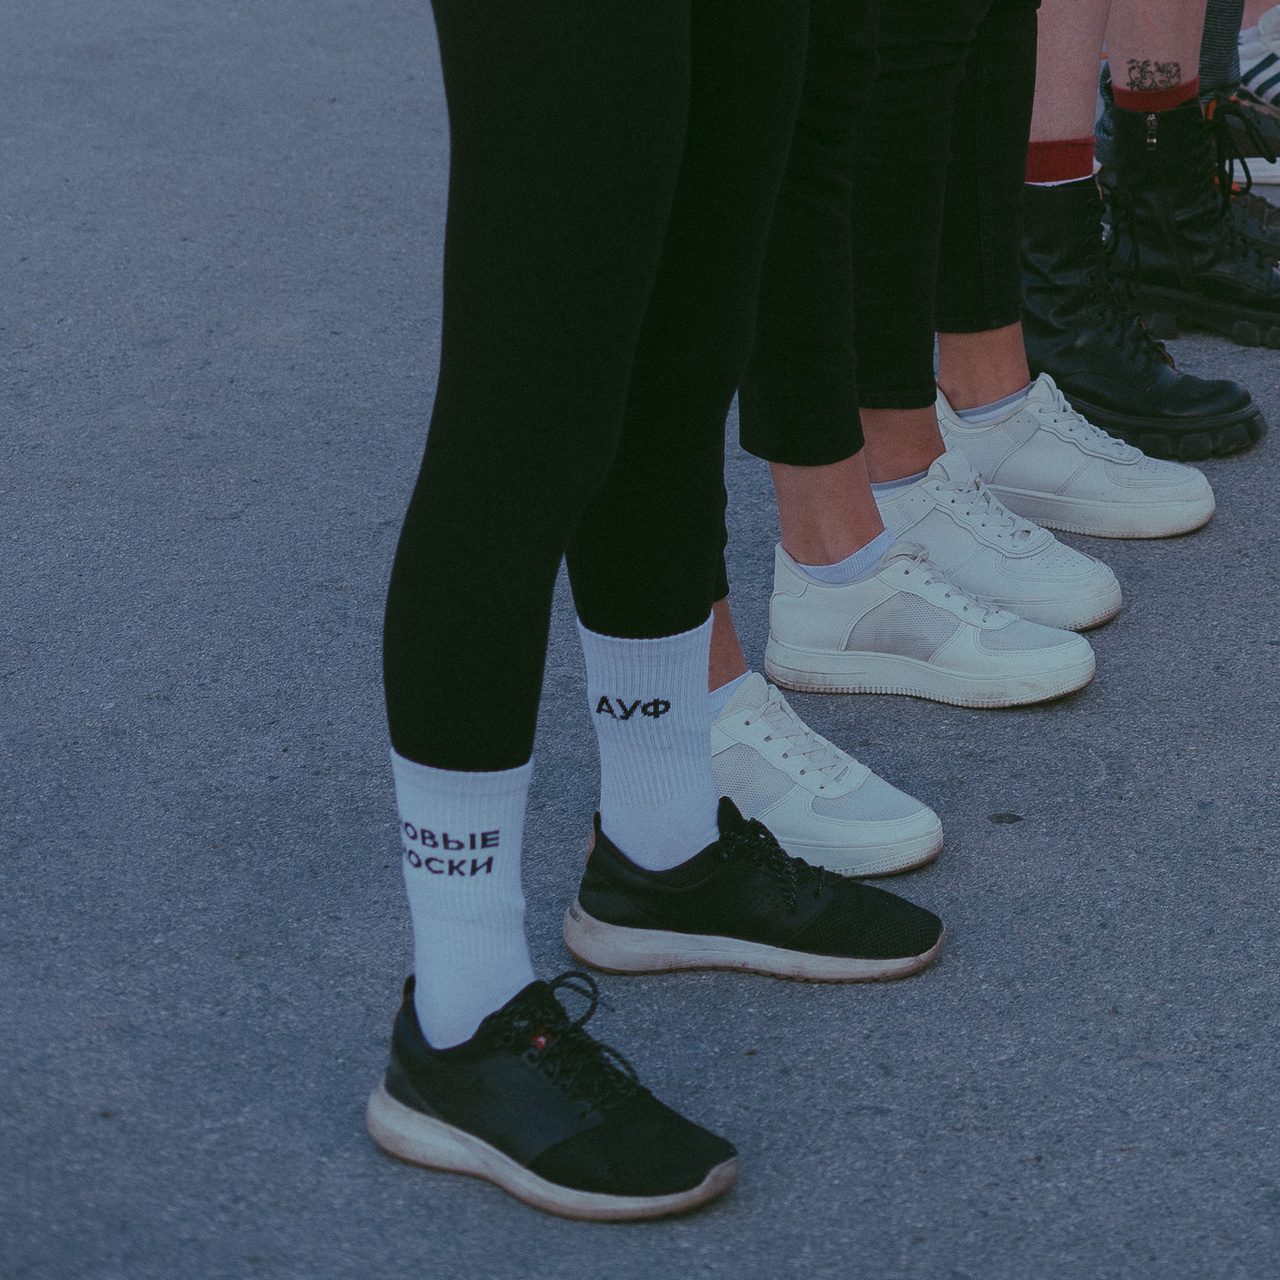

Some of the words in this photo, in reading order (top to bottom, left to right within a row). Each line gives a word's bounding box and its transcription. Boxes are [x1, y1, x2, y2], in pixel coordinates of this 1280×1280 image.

[596, 696, 670, 720] АУФ
[402, 822, 500, 851] ОВЫЕ
[403, 848, 493, 877] ОСКИ
